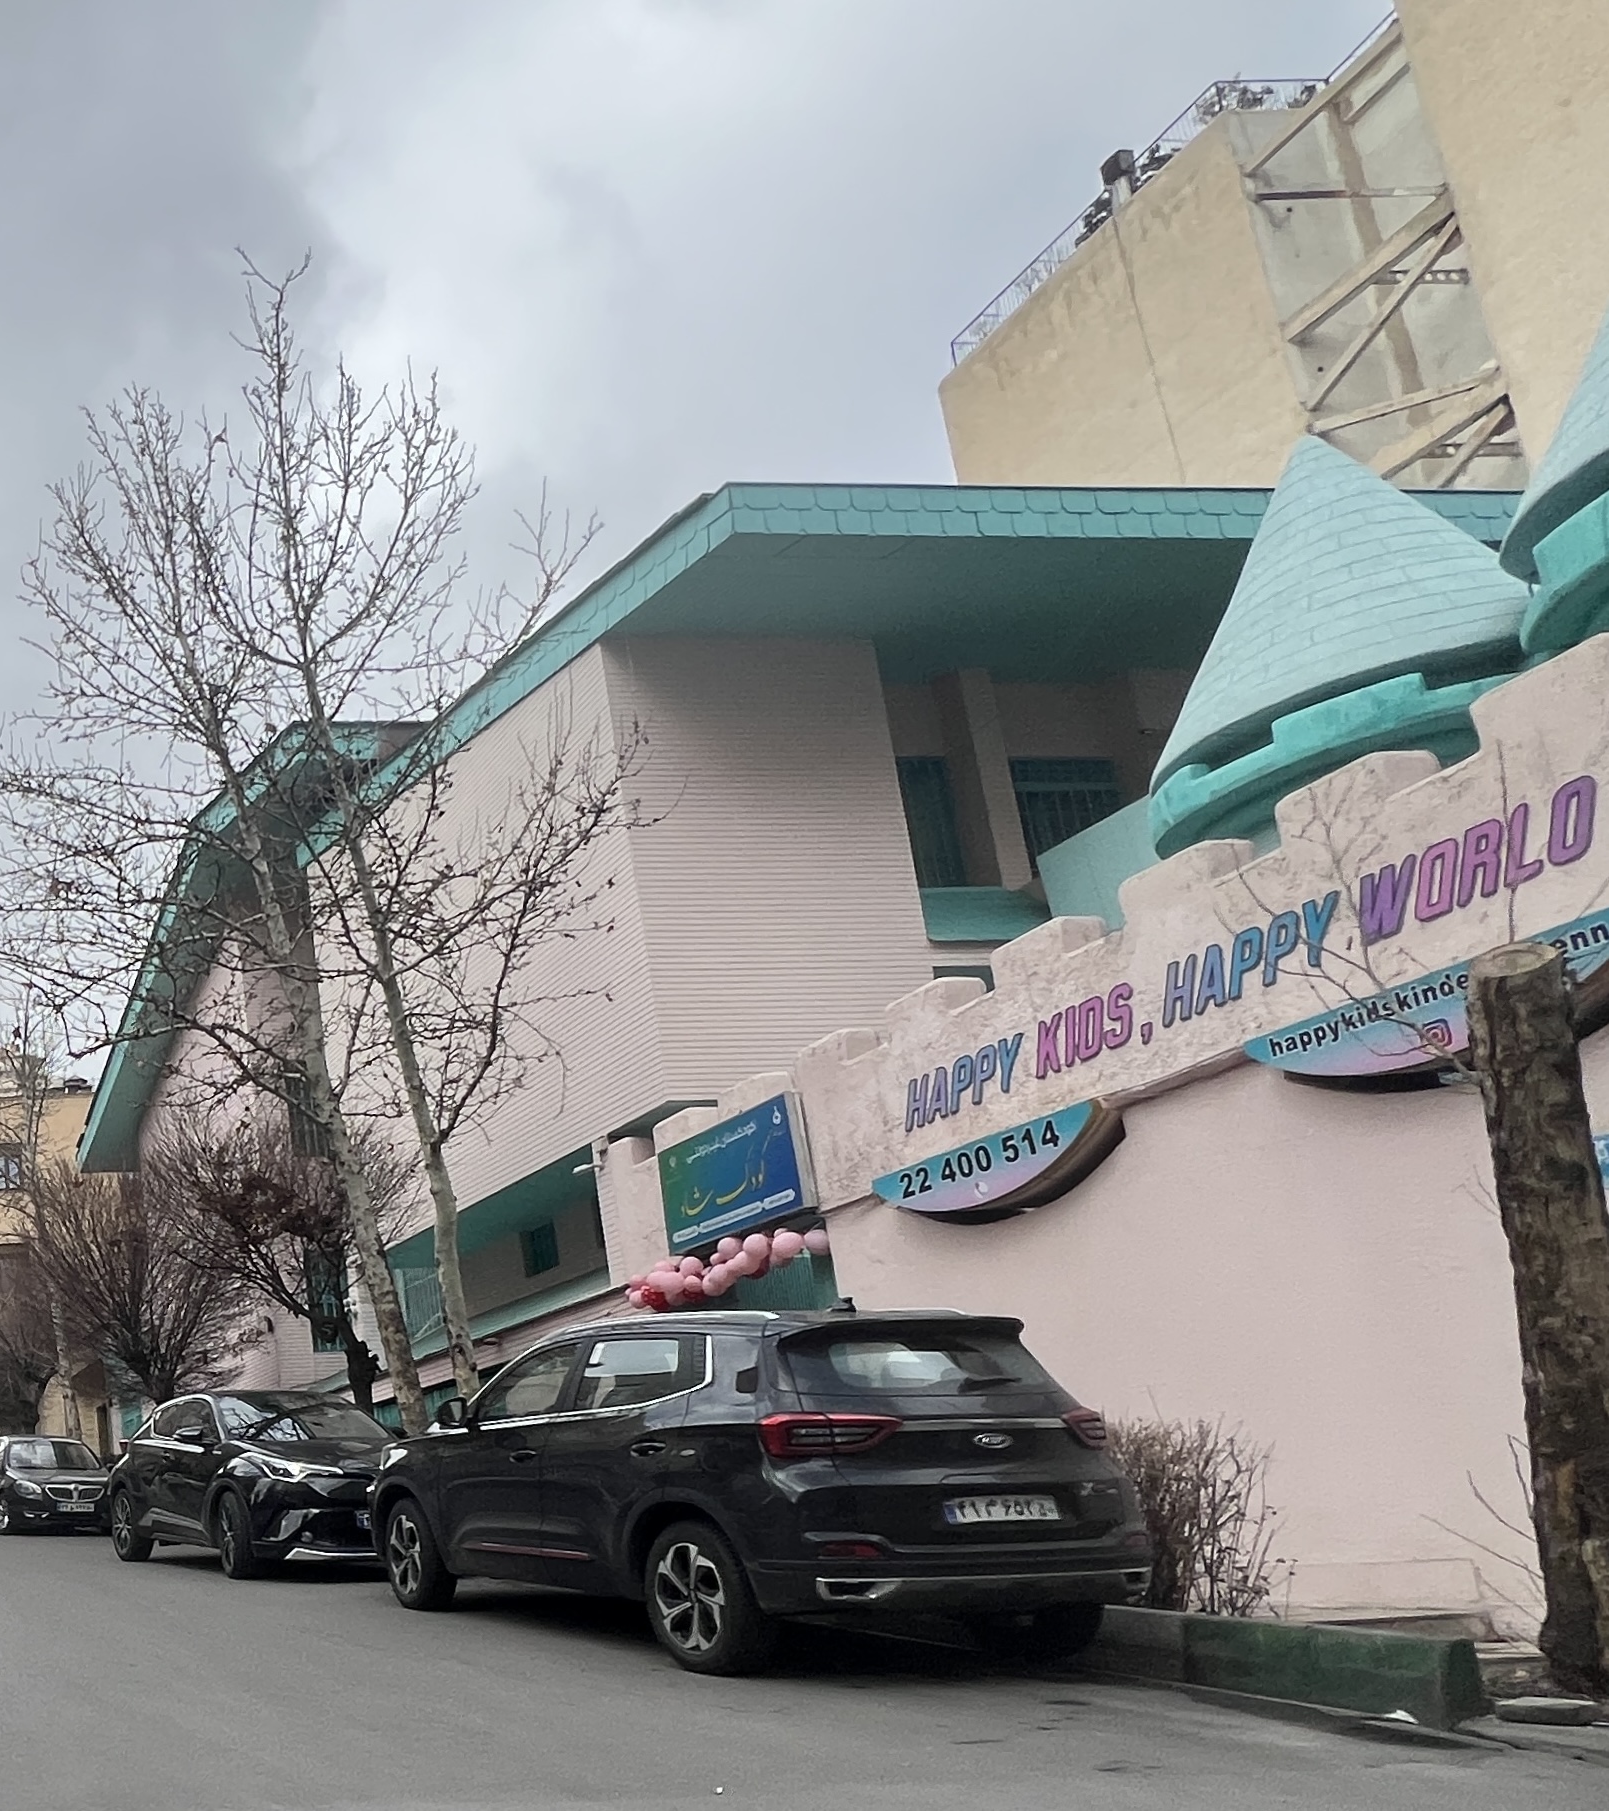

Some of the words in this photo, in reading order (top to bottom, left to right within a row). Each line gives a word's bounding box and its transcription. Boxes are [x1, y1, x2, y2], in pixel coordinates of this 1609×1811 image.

[905, 1032, 1024, 1133] HAPPY
[1036, 982, 1153, 1080] KIDS,
[1162, 890, 1341, 1029] HAPPY
[899, 1167, 933, 1199] 22
[941, 1145, 992, 1183] 400
[1001, 1120, 1061, 1163] 514
